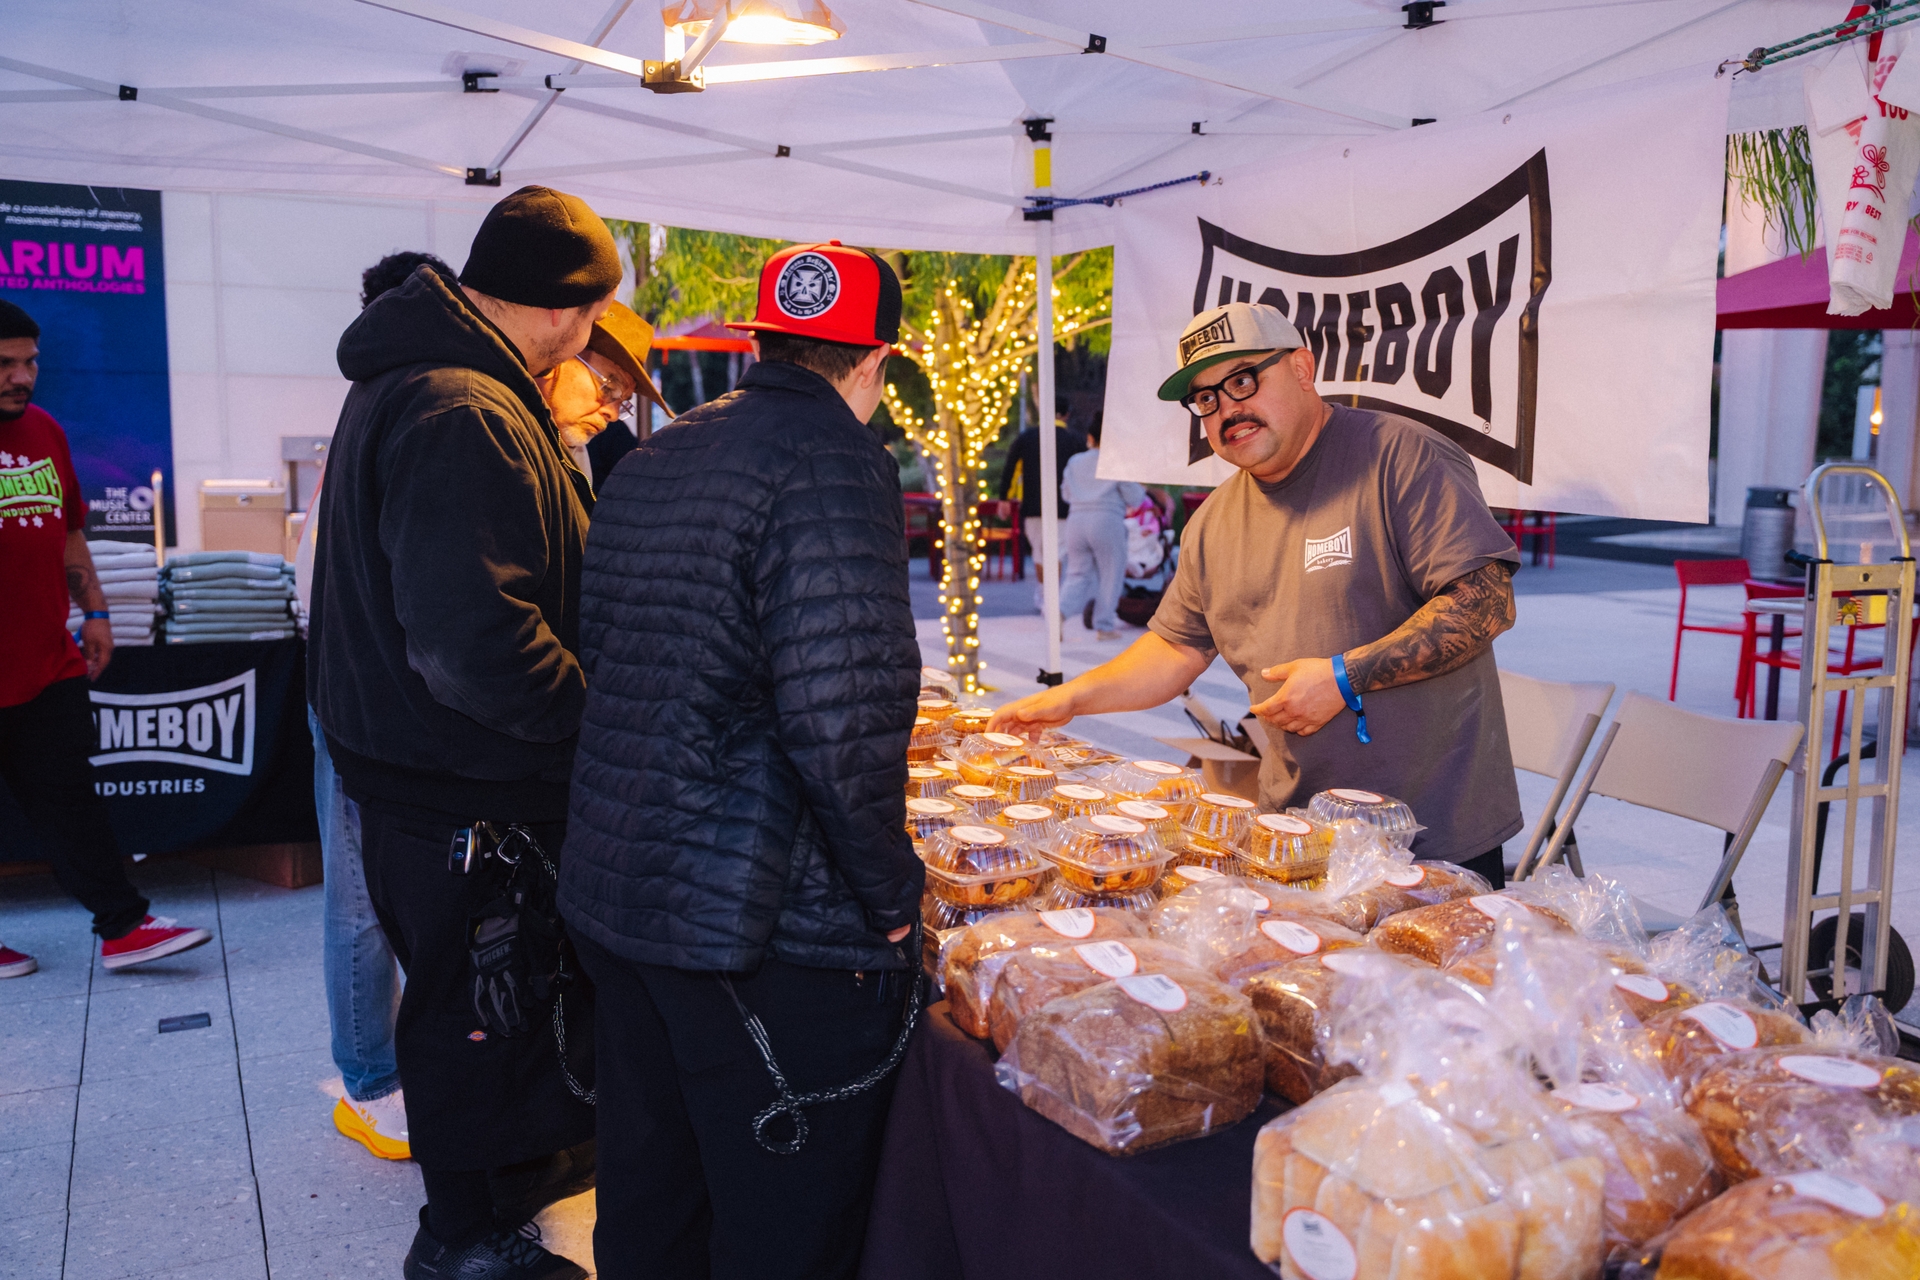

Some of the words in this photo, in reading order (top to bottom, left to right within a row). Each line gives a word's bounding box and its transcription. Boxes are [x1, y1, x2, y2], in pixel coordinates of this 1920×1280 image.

[1865, 204, 1882, 220] BEST
[5, 215, 60, 227] movement
[60, 218, 80, 228] and
[32, 278, 146, 294] ANTHOLOGIES
[1218, 233, 1520, 421] MEBOY
[105, 487, 128, 499] THE
[90, 499, 130, 511] MUSIC
[105, 511, 151, 524] CENTER
[1307, 533, 1347, 562] HOMEBOY
[93, 693, 242, 759] MEBOY
